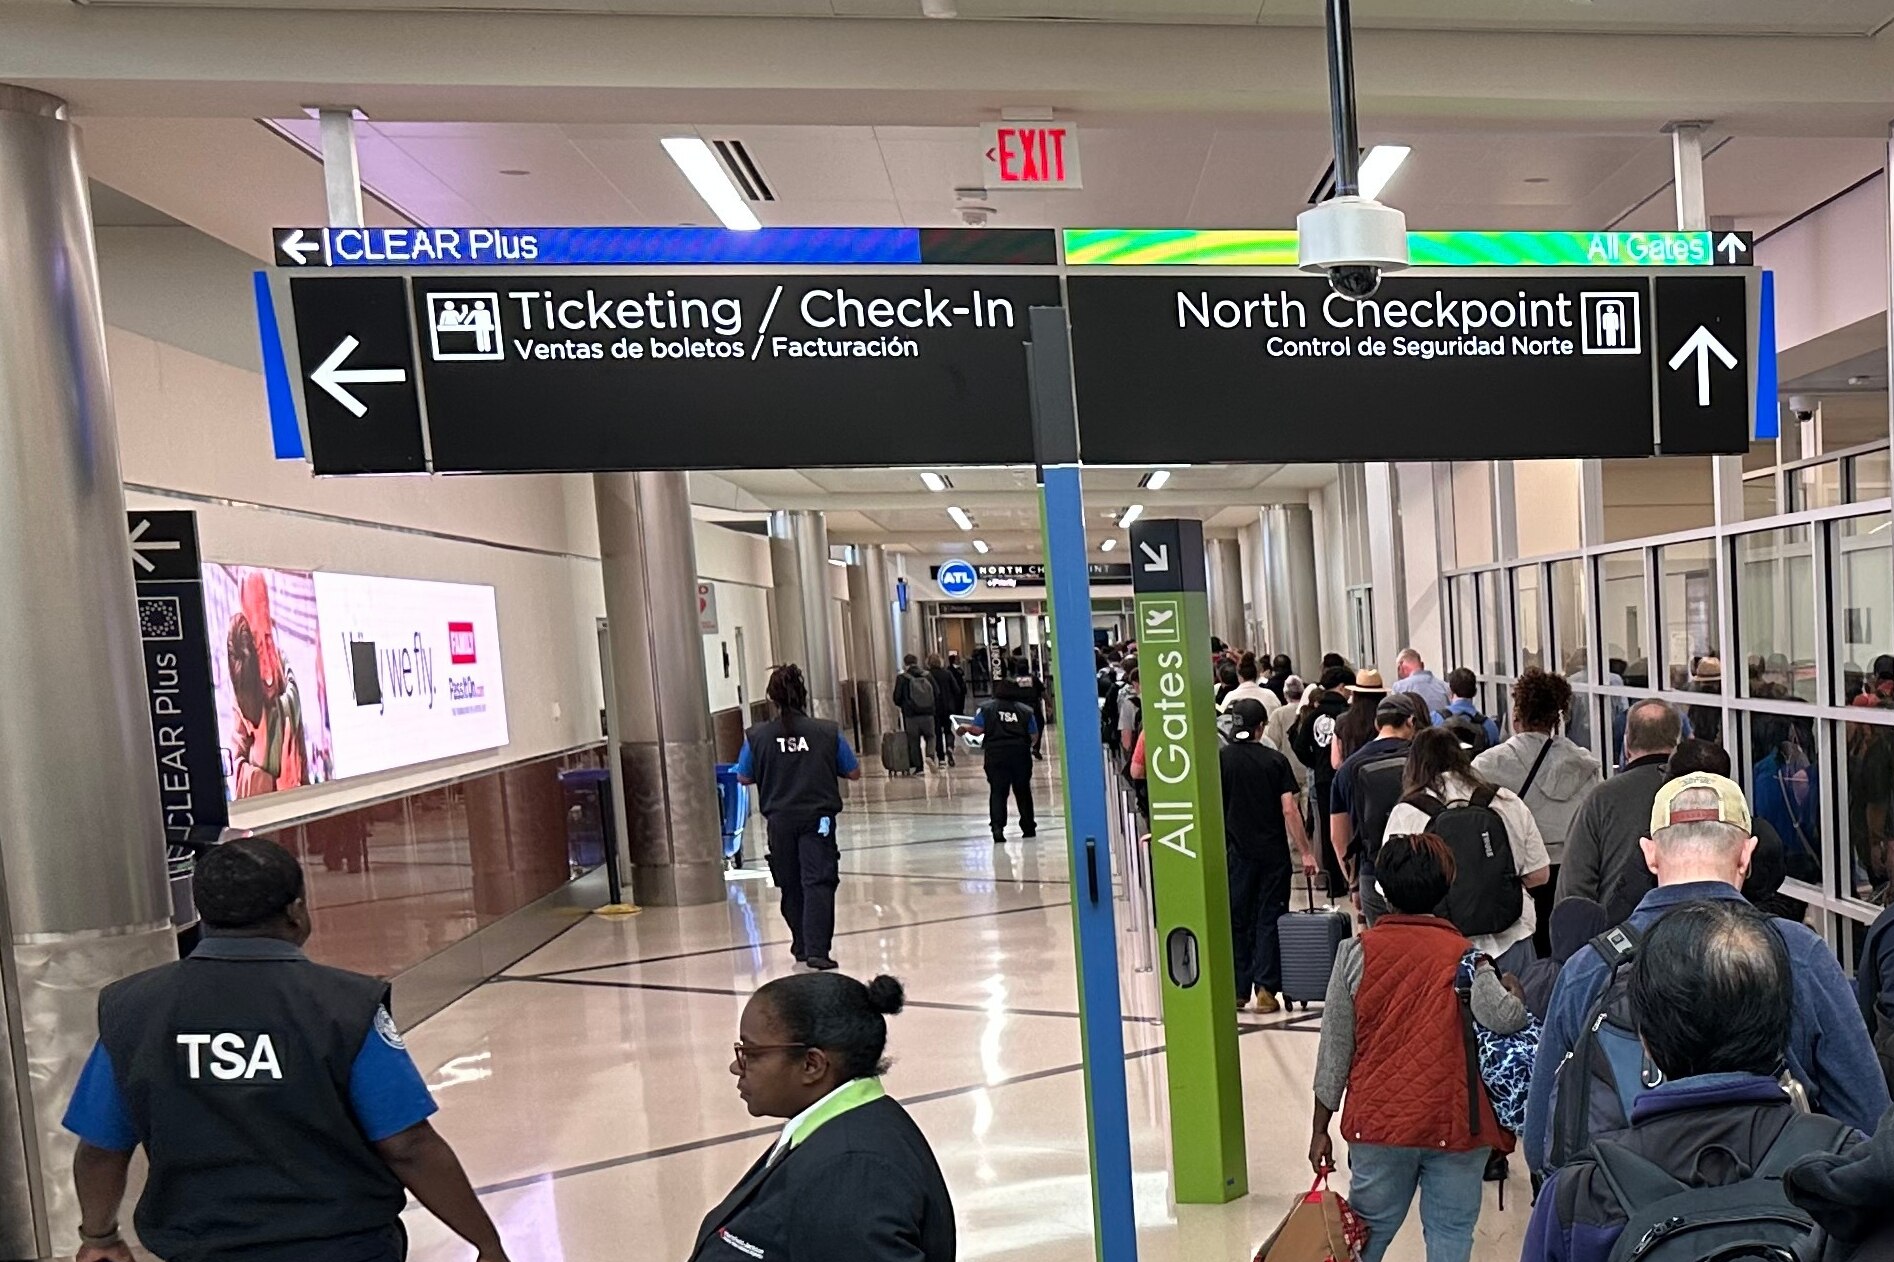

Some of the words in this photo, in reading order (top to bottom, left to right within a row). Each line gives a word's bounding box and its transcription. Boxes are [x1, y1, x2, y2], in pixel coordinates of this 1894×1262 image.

[997, 128, 1066, 181] EXIT
[335, 229, 462, 260] CLEAR
[469, 229, 539, 260] Plus
[1587, 234, 1619, 260] All
[1626, 233, 1704, 261] Gates
[508, 289, 742, 335] Ticketing
[800, 288, 1015, 328] Check-In
[1177, 290, 1306, 328] North
[1322, 290, 1573, 335] Checkpoint
[513, 338, 604, 360] Ventas
[611, 338, 644, 359] de
[651, 336, 745, 358] boletos
[771, 335, 919, 358] Facturación
[1266, 336, 1351, 357] Control
[1357, 336, 1386, 357] de
[1392, 336, 1505, 360] Seguridad
[1511, 336, 1574, 356] Norte
[943, 571, 973, 584] ATL
[979, 565, 1023, 574] NORTH
[152, 652, 183, 715] Plus
[386, 648, 414, 698] we
[998, 710, 1019, 723] TSA
[1151, 650, 1191, 784] Gates
[776, 736, 810, 753] TSA
[158, 726, 195, 826] CLEAR
[1152, 801, 1197, 859] All
[176, 1032, 283, 1080] TSA
